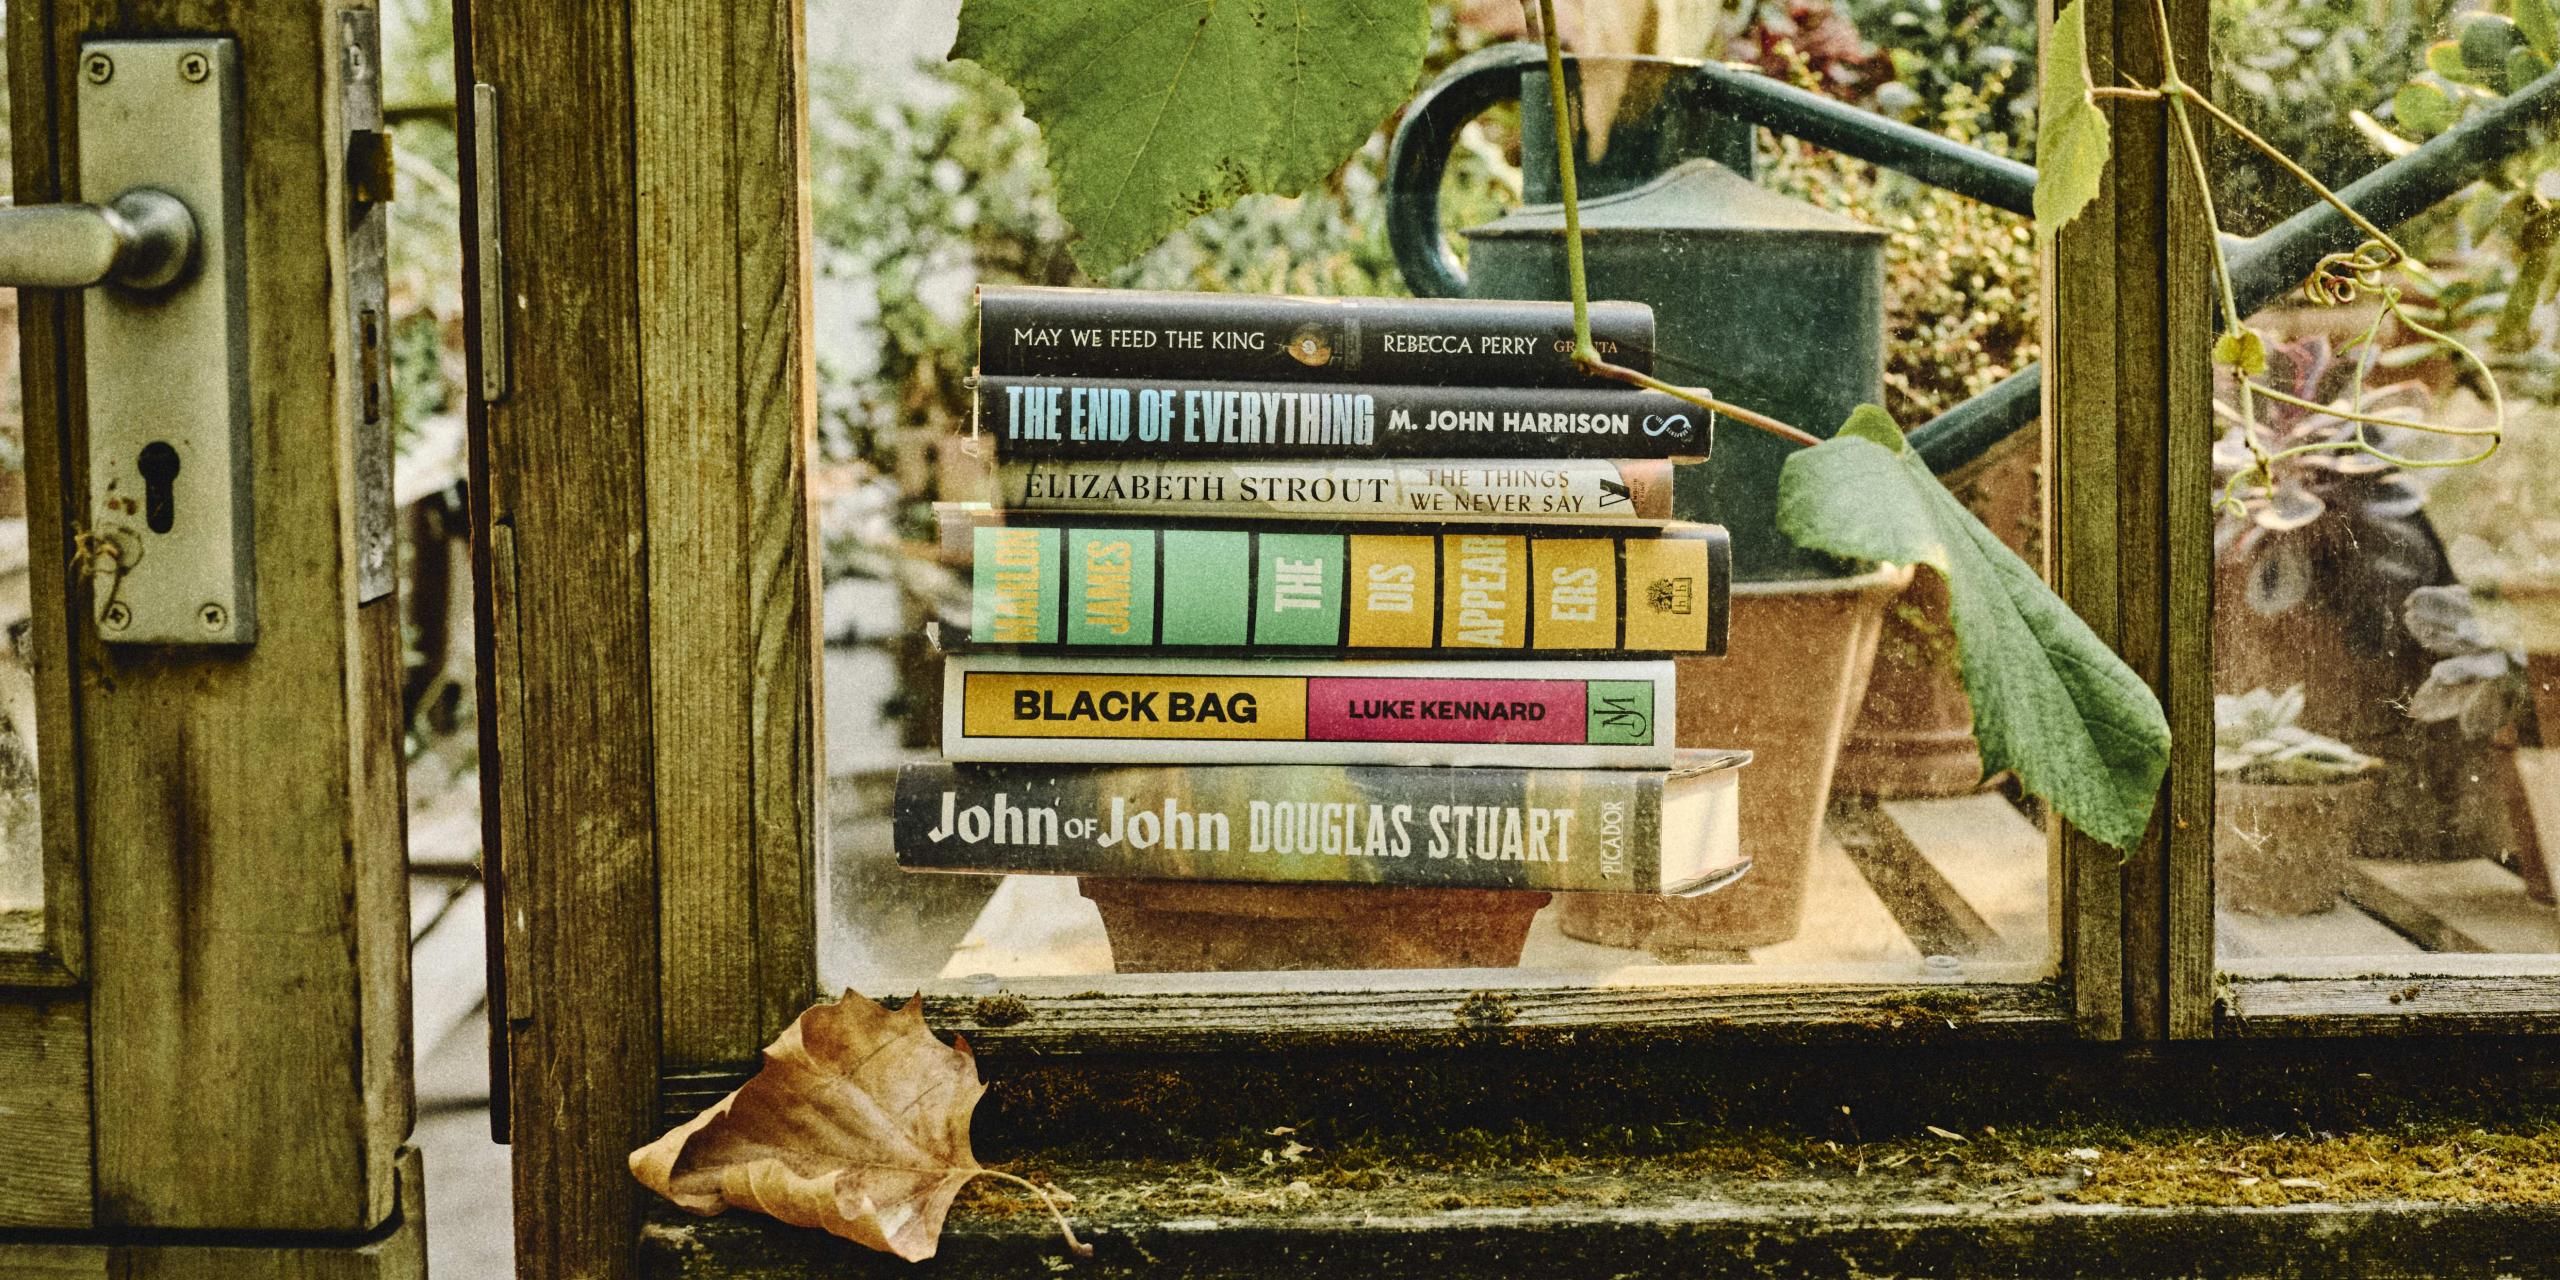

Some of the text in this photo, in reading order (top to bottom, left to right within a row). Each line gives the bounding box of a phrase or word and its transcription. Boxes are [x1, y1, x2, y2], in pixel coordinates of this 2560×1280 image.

[1014, 328, 1265, 350] MAY WE FEED THE KING
[1384, 334, 1538, 355] REBECCA PERRY
[1553, 339, 1618, 353] GRTA
[1005, 386, 1375, 446] THE END OF EVERYTHING
[1388, 409, 1418, 431] M.
[1425, 410, 1495, 432] JOHN
[1503, 412, 1630, 435] HARRISON
[1025, 473, 1390, 503] ELIZABETH STROUT
[1410, 493, 1584, 513] WE NEVER SAY
[1425, 469, 1570, 489] THE THINGS
[993, 529, 1040, 642] MARLON
[1086, 539, 1132, 635] JAMES
[1274, 556, 1323, 613] THE
[1367, 563, 1416, 612] DIS
[1457, 536, 1509, 647] APPEAR
[1552, 565, 1598, 622] ERS
[1014, 689, 1257, 724] BLACK BAG
[1349, 699, 1546, 721] LUKE KENNARD
[927, 791, 1230, 851] John OF John
[1248, 800, 1575, 862] DOUGLAS STUART
[1602, 800, 1623, 874] PICADOR
